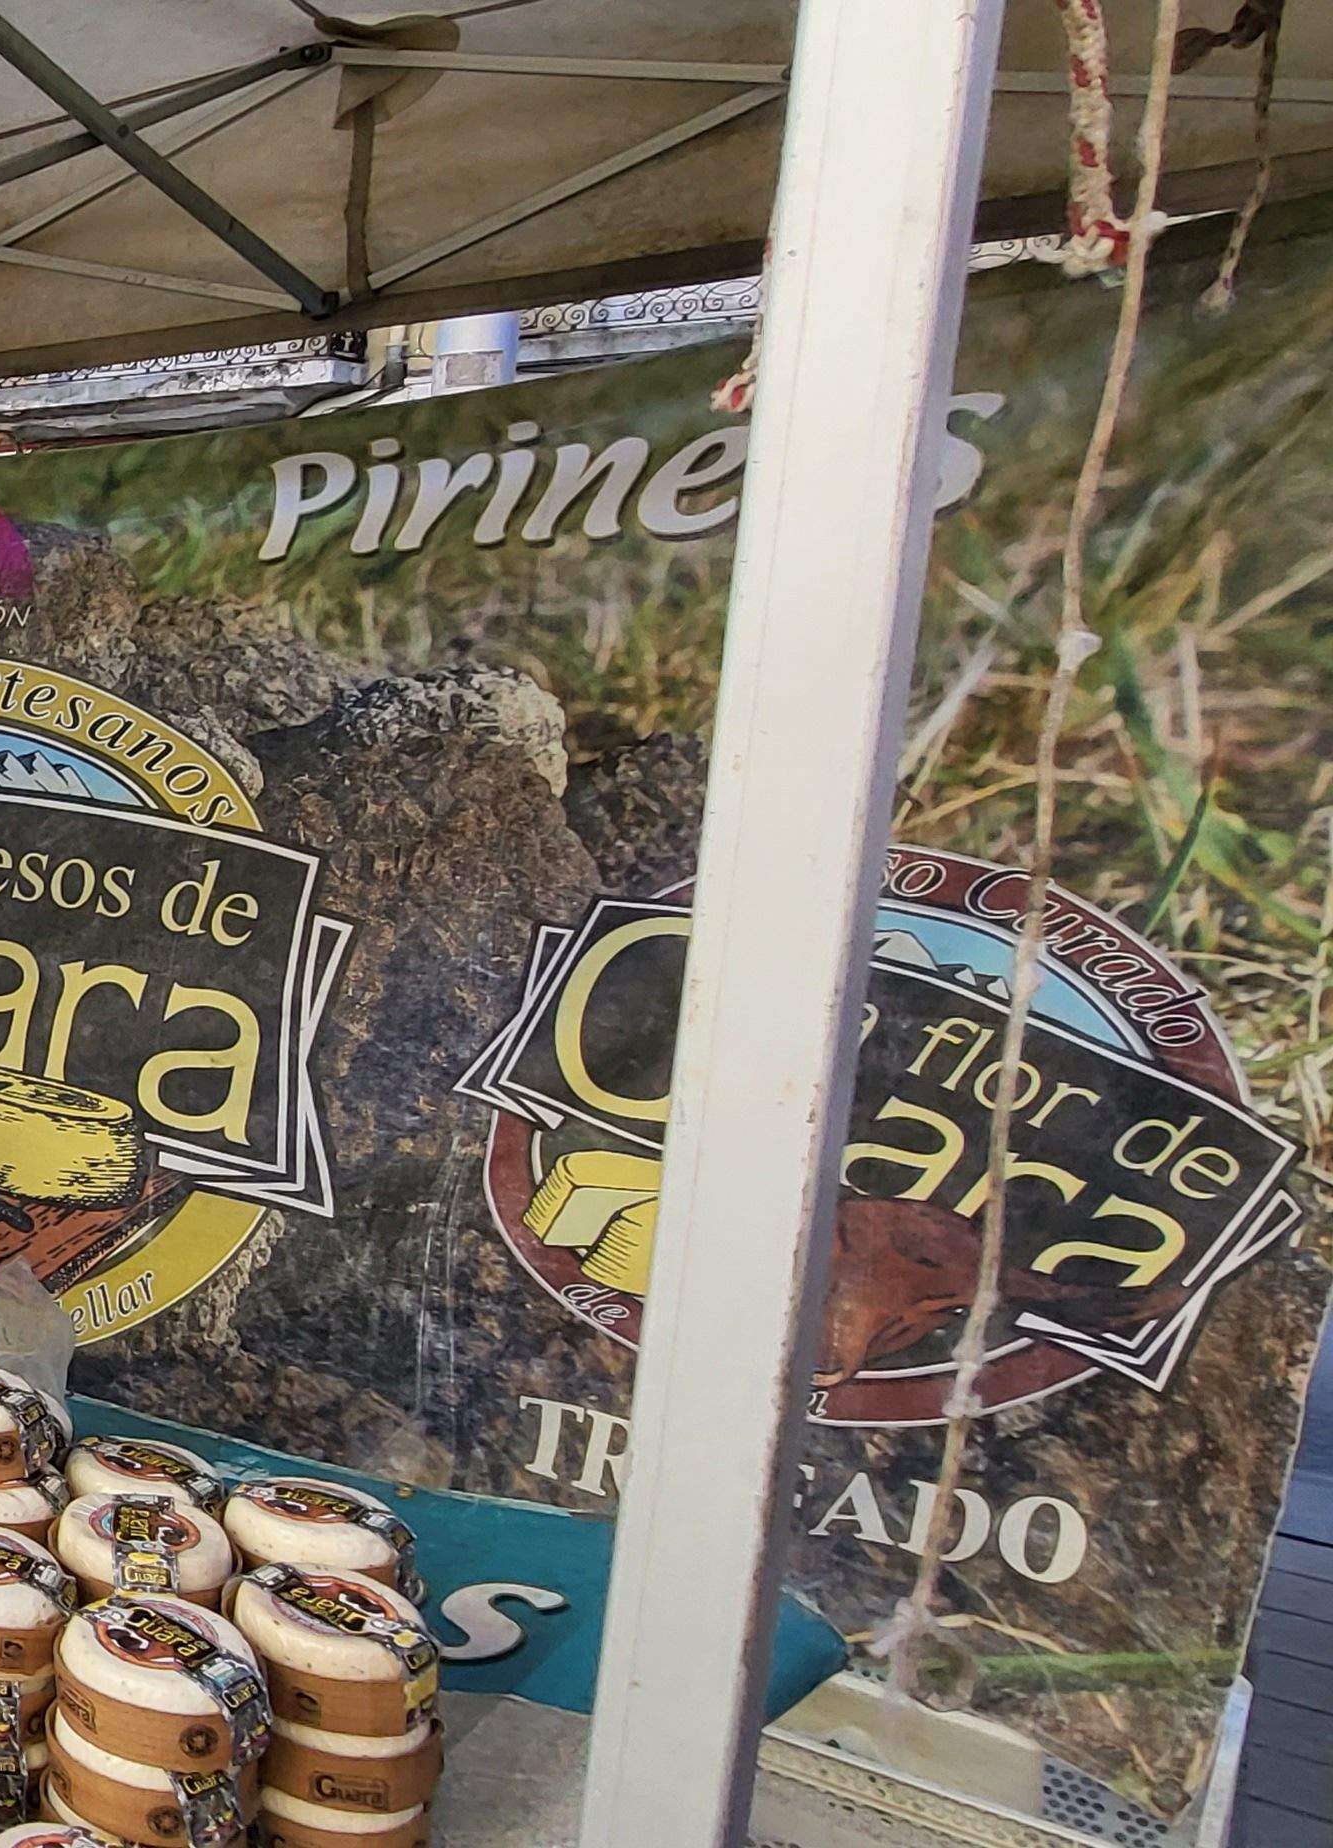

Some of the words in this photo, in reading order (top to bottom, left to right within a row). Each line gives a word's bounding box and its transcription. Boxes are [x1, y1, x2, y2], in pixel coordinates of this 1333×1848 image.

[256, 391, 1006, 562] Pirines
[159, 860, 260, 946] de
[907, 1016, 1102, 1130] flor
[1114, 1116, 1242, 1200] de
[132, 1606, 199, 1658] Guara
